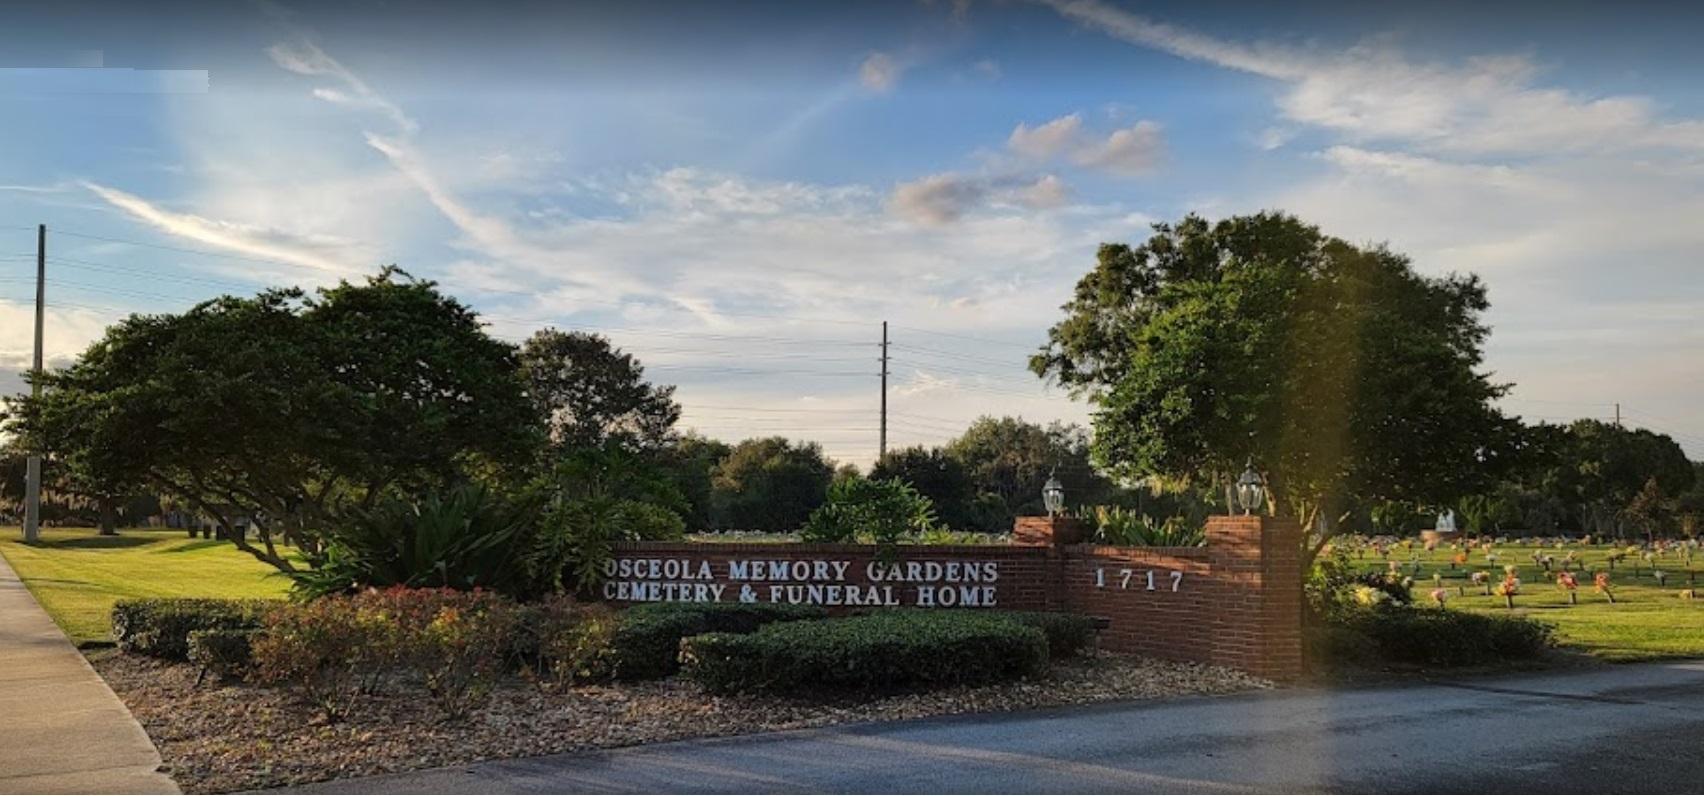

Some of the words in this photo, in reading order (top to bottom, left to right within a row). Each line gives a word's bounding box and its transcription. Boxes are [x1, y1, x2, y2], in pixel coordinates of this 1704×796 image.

[604, 559, 713, 579] OSCEOLA
[729, 560, 850, 581] MEMORY
[867, 561, 999, 582] GARDENS
[1096, 568, 1183, 592] 1717
[603, 581, 726, 603] CEMETERY
[739, 584, 758, 603] &
[770, 585, 900, 605] FUNERAL
[917, 586, 998, 606] HOME
